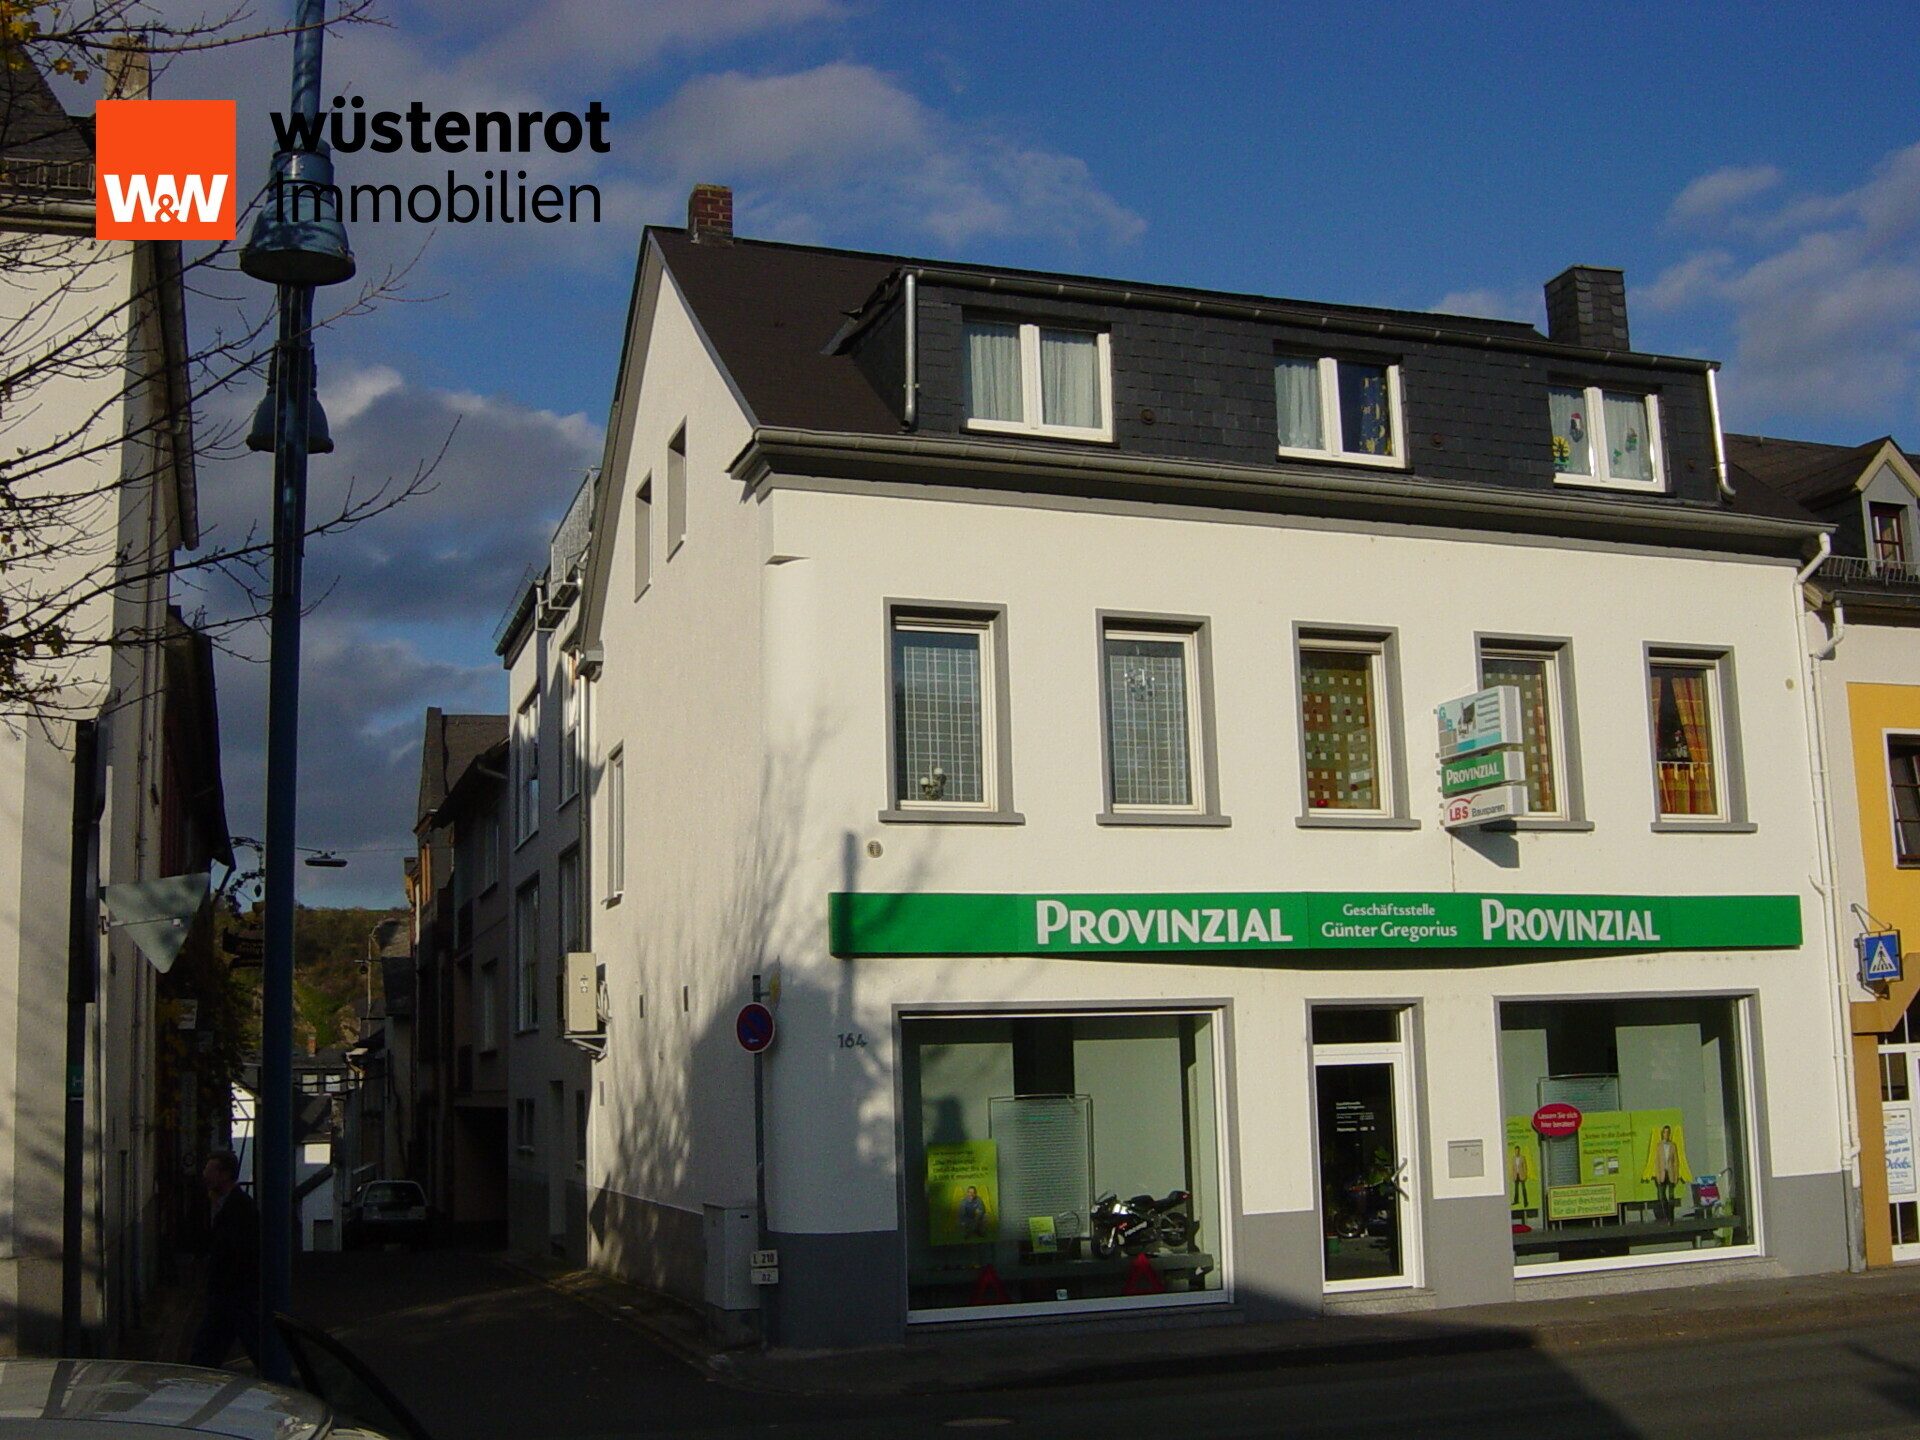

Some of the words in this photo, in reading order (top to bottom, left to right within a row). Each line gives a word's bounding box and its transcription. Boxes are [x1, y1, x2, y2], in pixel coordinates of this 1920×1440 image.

[1446, 763, 1500, 785] PROVINZIAL
[1449, 805, 1468, 821] LBS
[1471, 804, 1505, 818] Bausparen
[1343, 903, 1435, 917] Geschäftsstelle
[1481, 898, 1661, 942] PROVINZIAL
[1036, 899, 1293, 945] PROVINZIAL
[1321, 921, 1379, 940] Günter
[1381, 921, 1458, 942] Gregorius
[837, 1033, 869, 1049] 164
